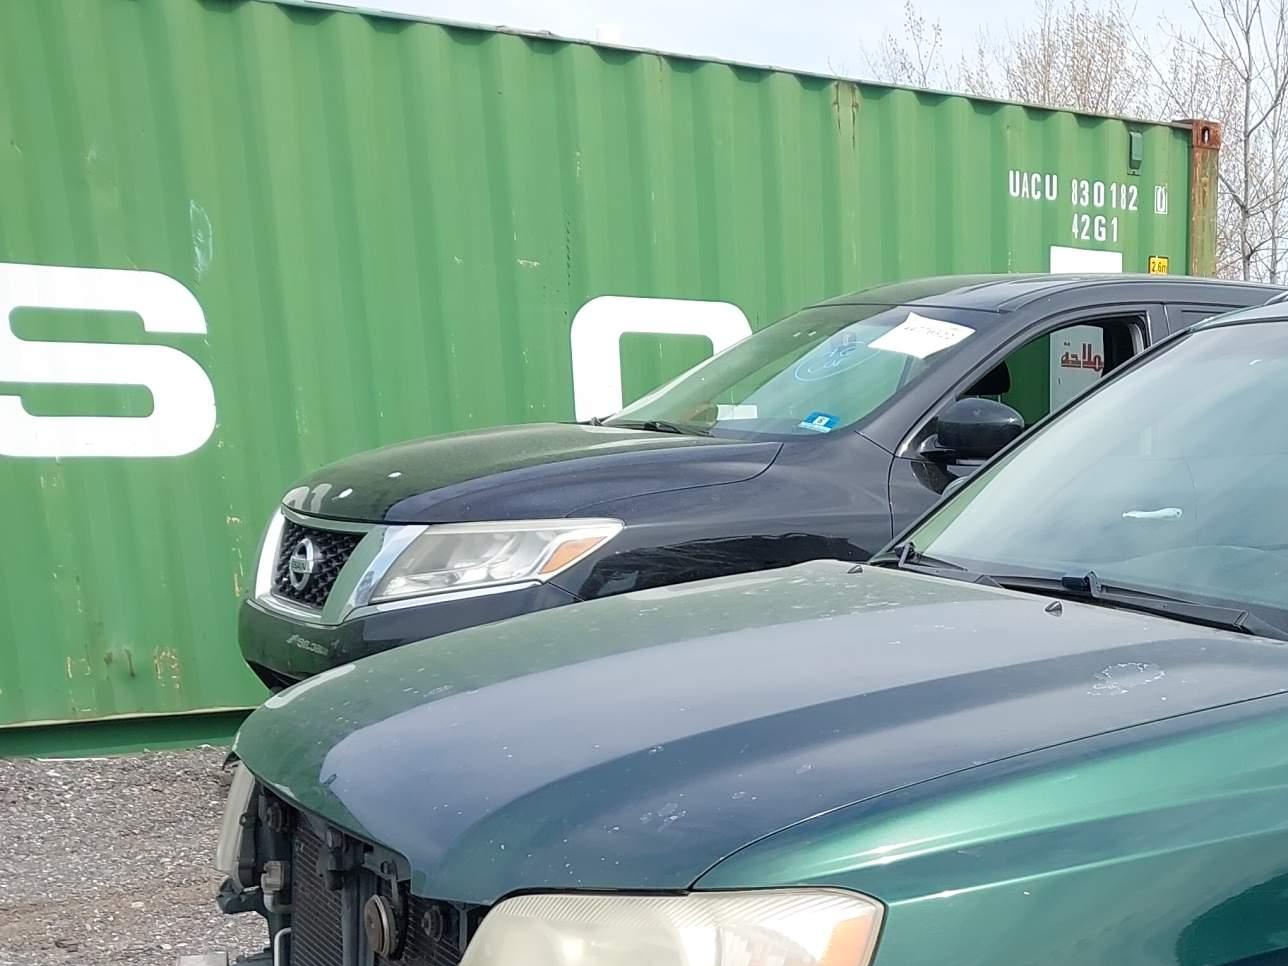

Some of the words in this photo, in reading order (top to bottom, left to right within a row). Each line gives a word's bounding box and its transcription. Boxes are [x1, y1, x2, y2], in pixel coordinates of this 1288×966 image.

[1008, 170, 1058, 201] UACU
[1071, 178, 1138, 211] 830182
[1071, 213, 1118, 242] 42G1
[0, 262, 217, 457] S
